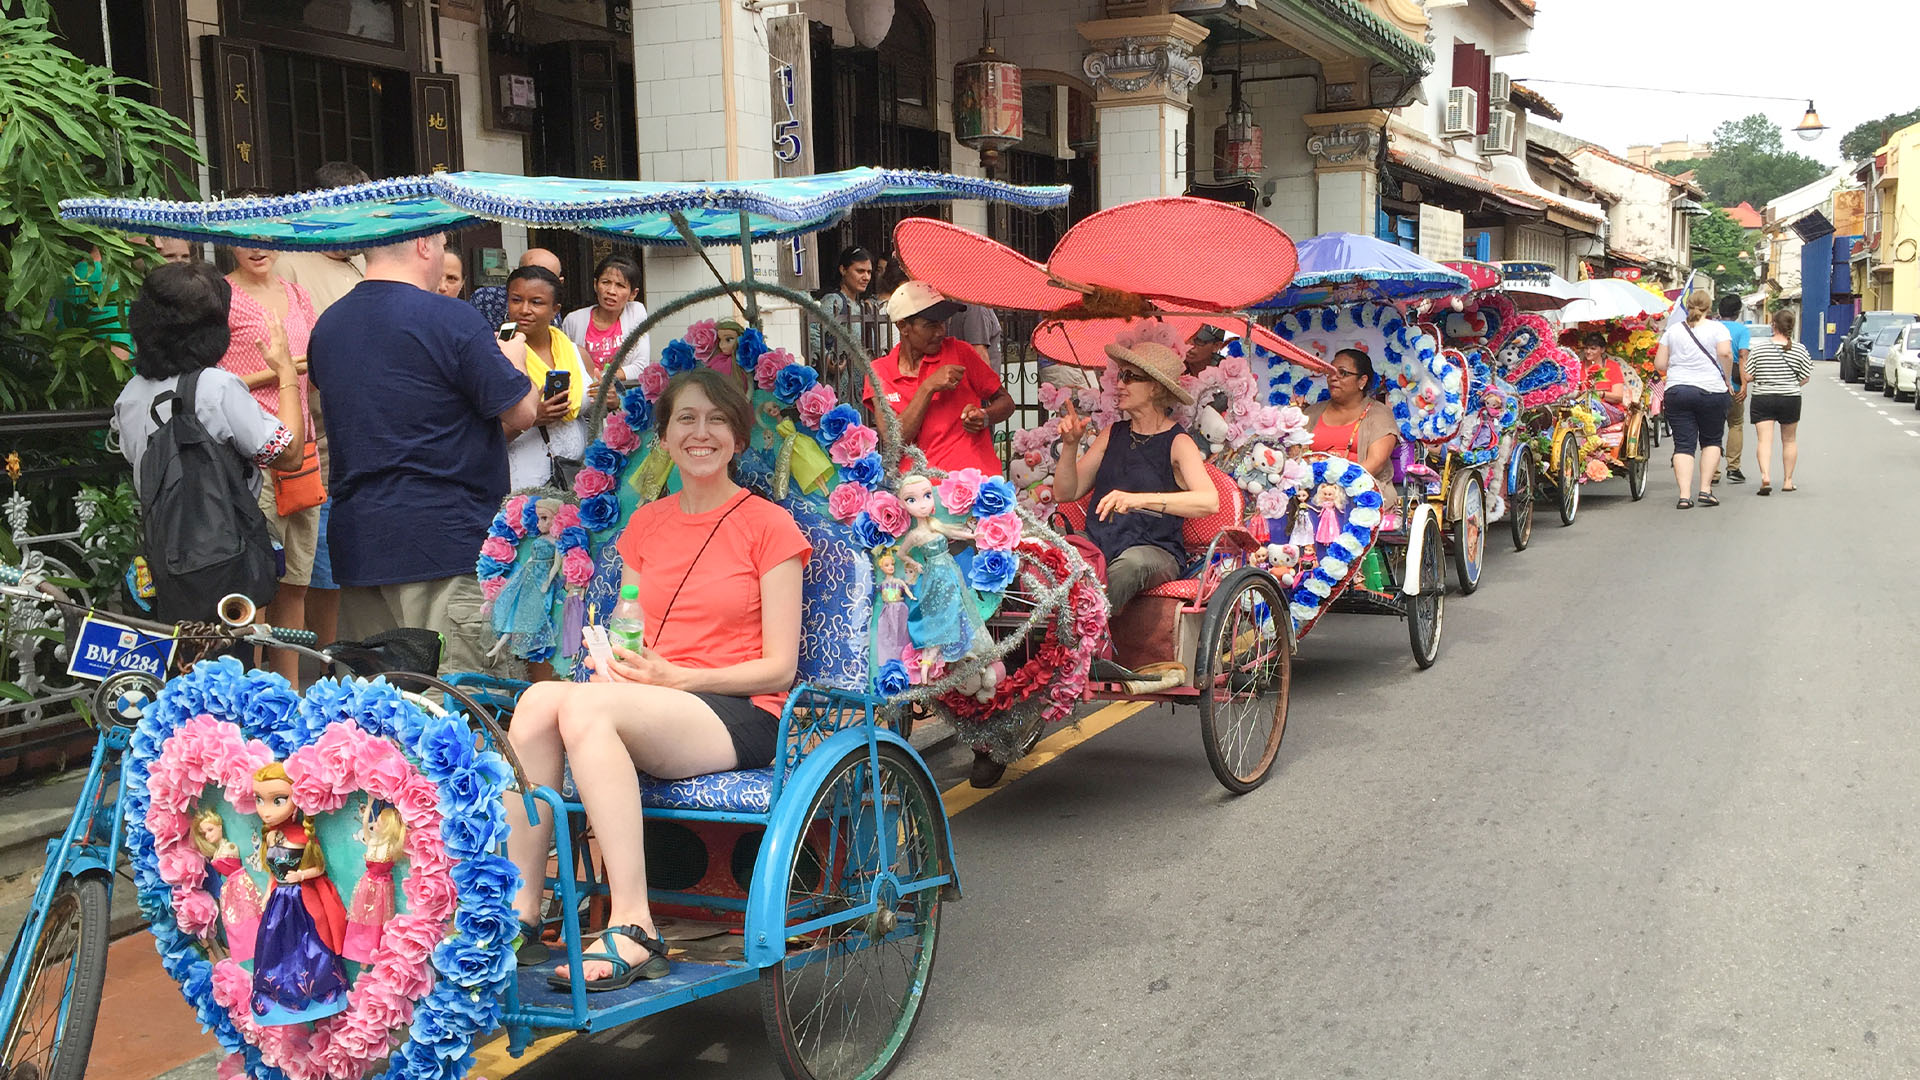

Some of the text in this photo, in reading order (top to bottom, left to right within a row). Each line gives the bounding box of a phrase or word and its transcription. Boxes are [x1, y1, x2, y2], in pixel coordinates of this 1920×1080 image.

[84, 643, 119, 665] BM
[120, 653, 160, 674] 0284
[107, 682, 142, 709] BMW
